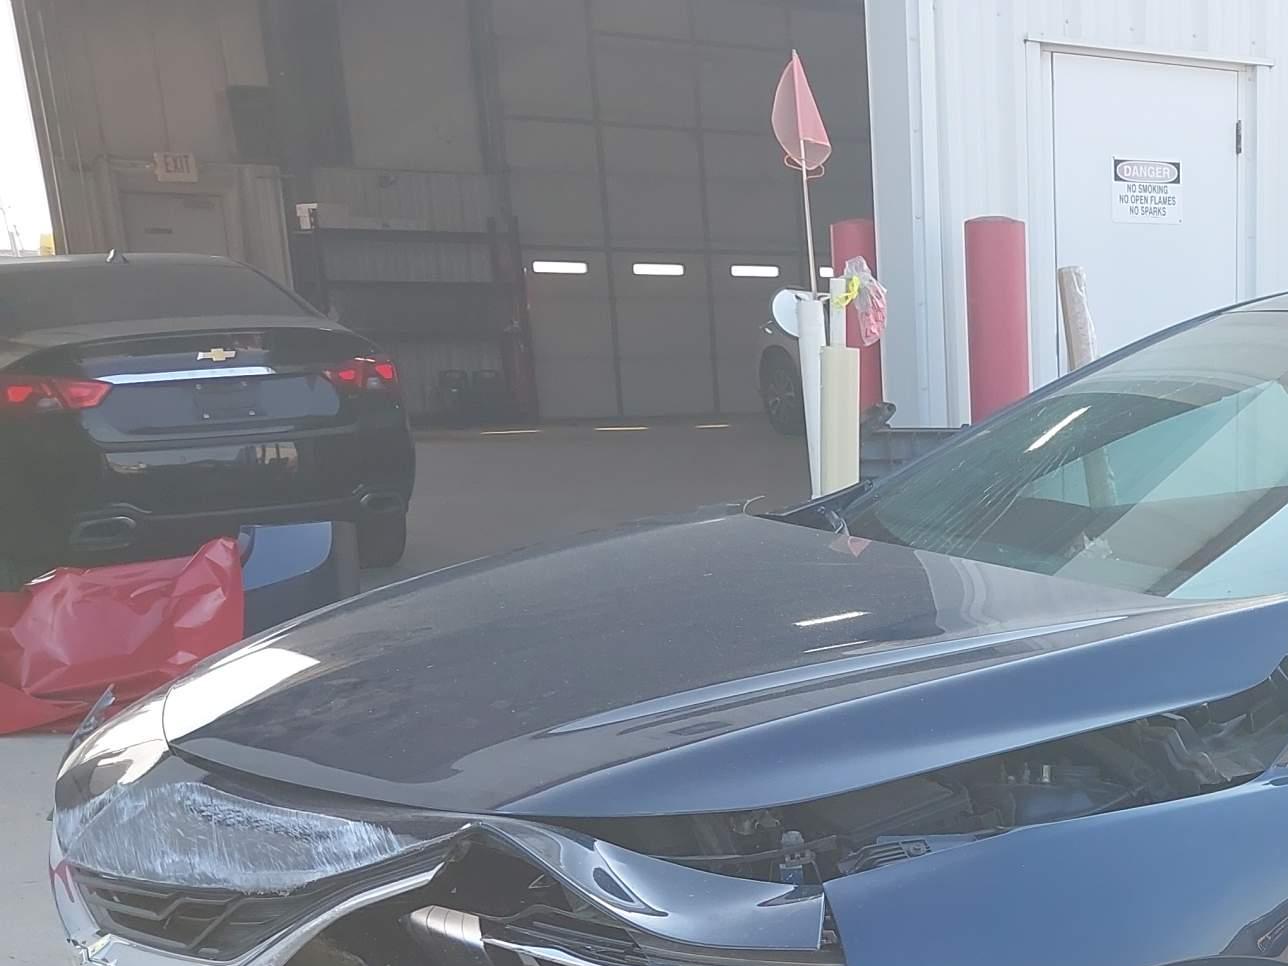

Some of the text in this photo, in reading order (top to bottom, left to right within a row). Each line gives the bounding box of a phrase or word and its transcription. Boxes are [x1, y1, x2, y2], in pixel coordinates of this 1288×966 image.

[163, 154, 191, 174] EXIT
[1123, 165, 1170, 178] DANGER
[1127, 184, 1168, 194] NO SMOKING
[1120, 194, 1176, 206] NO OPEN FLAMES
[1130, 205, 1166, 216] NO SPARKS
